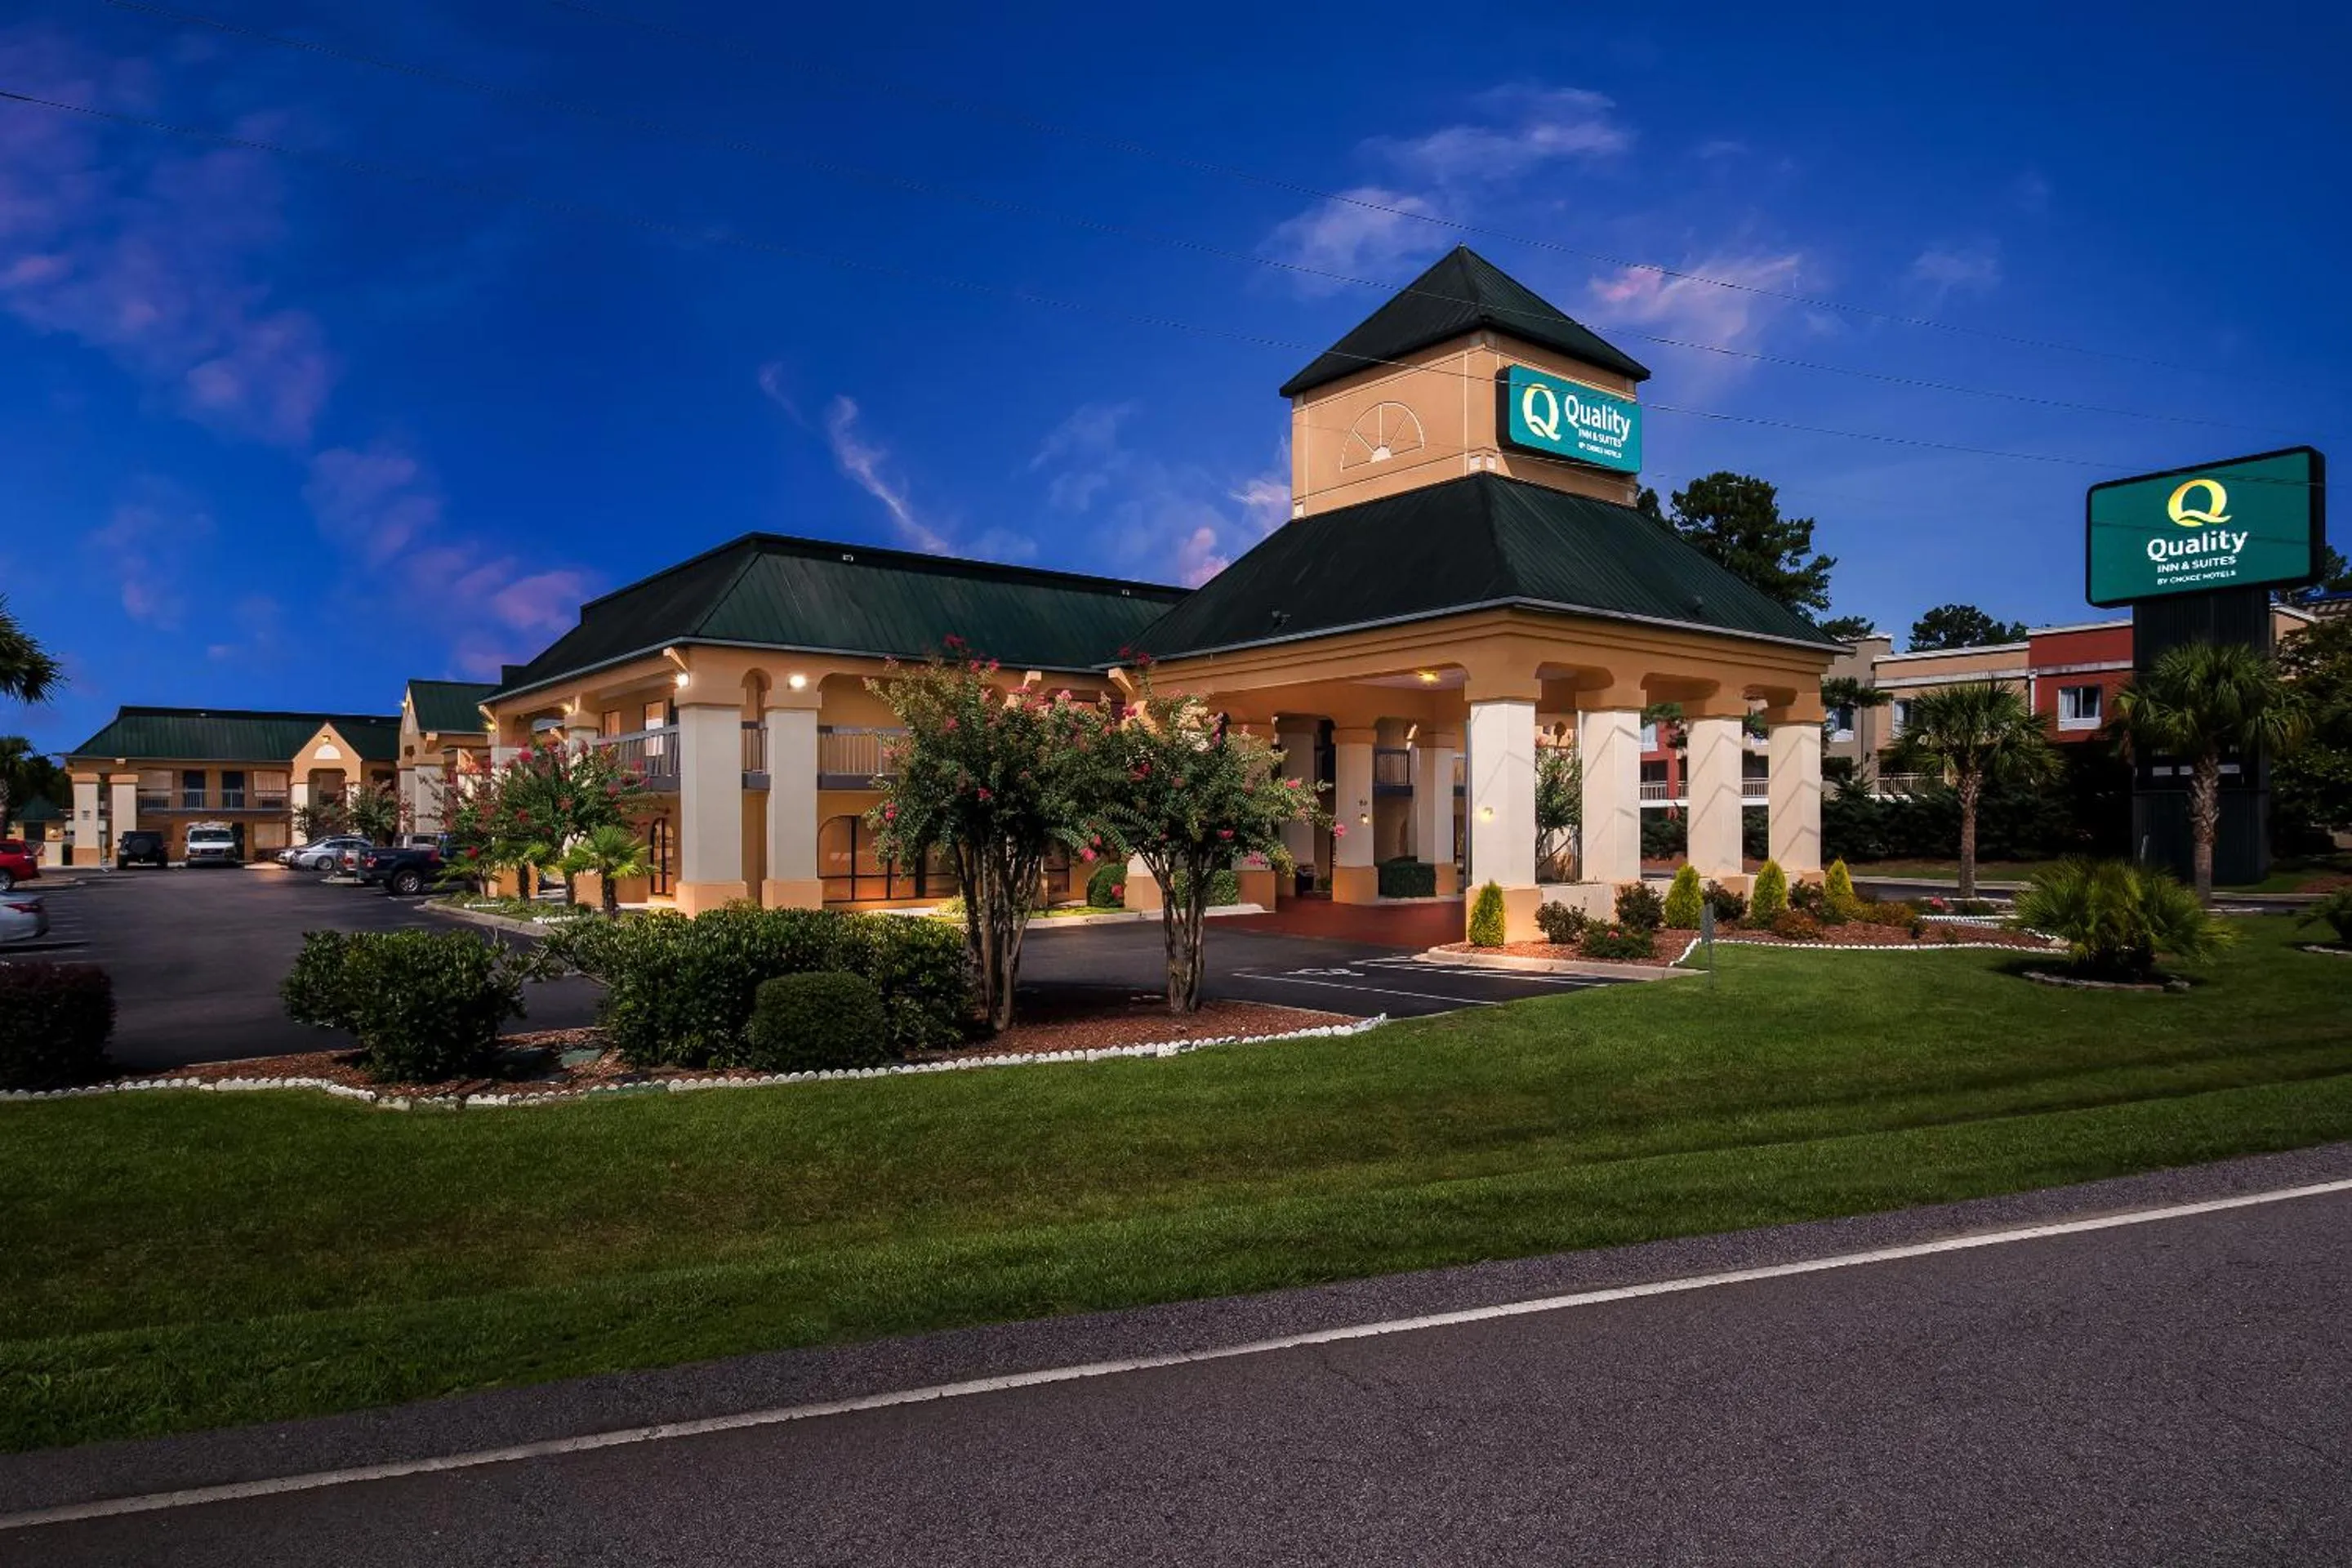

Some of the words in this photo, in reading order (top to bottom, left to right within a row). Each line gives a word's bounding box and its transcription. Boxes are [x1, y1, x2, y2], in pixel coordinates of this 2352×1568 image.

[1522, 384, 1561, 441] Q
[1565, 394, 1631, 442] Quality
[2167, 479, 2232, 528] Q
[2147, 530, 2248, 562] Quality
[2157, 563, 2180, 573] INN
[2181, 561, 2189, 570] &
[2191, 555, 2237, 569] SUITES
[2157, 577, 2168, 586] BY
[2169, 573, 2202, 584] CHOICE
[2203, 570, 2237, 579] HOTELS
